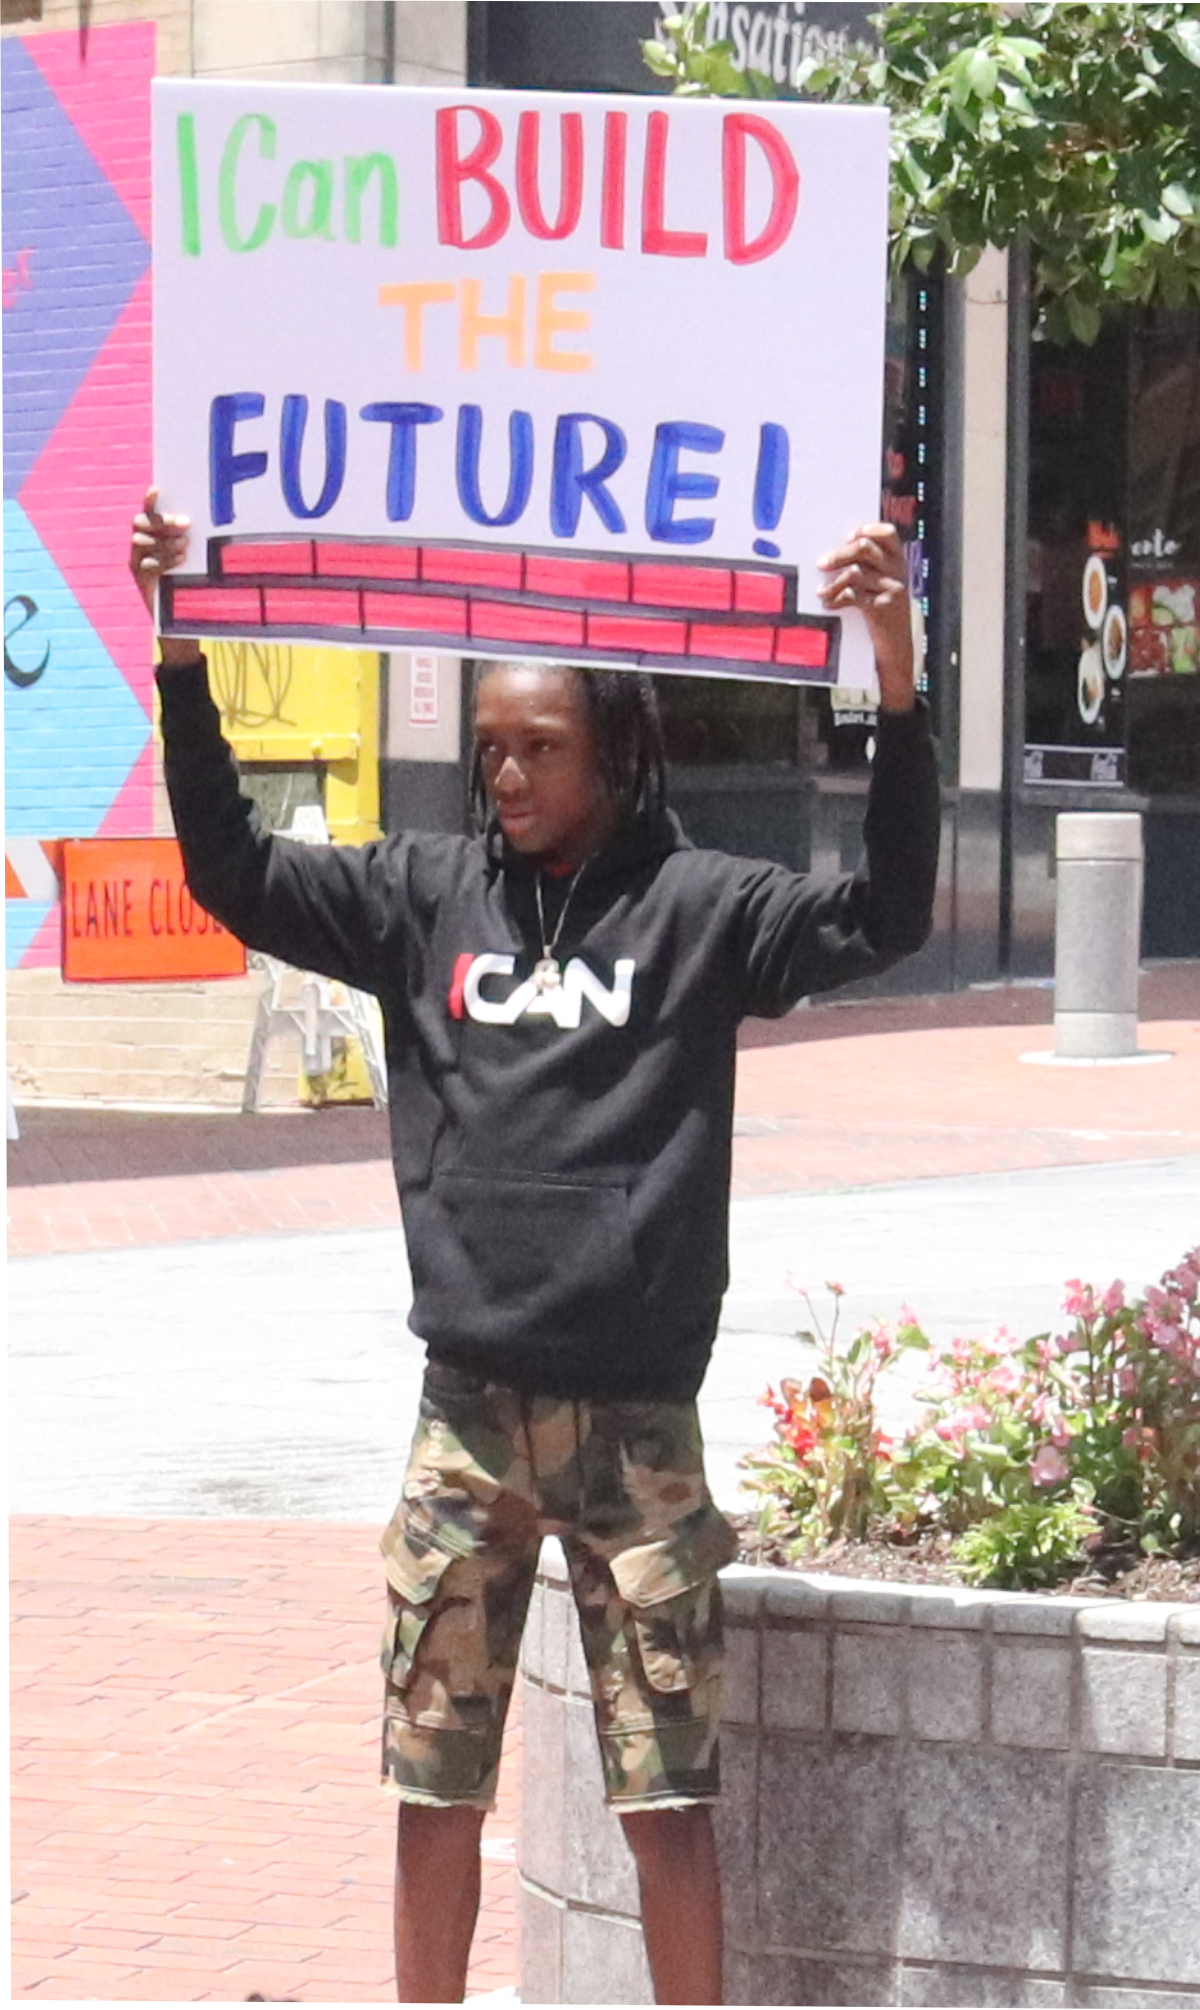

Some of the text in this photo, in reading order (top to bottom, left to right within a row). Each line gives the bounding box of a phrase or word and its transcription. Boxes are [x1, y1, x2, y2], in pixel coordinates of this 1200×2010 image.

[176, 104, 800, 265] I Can BUILD
[377, 271, 595, 373] THE
[208, 391, 791, 558] FUTURE!
[71, 879, 134, 938] LANE
